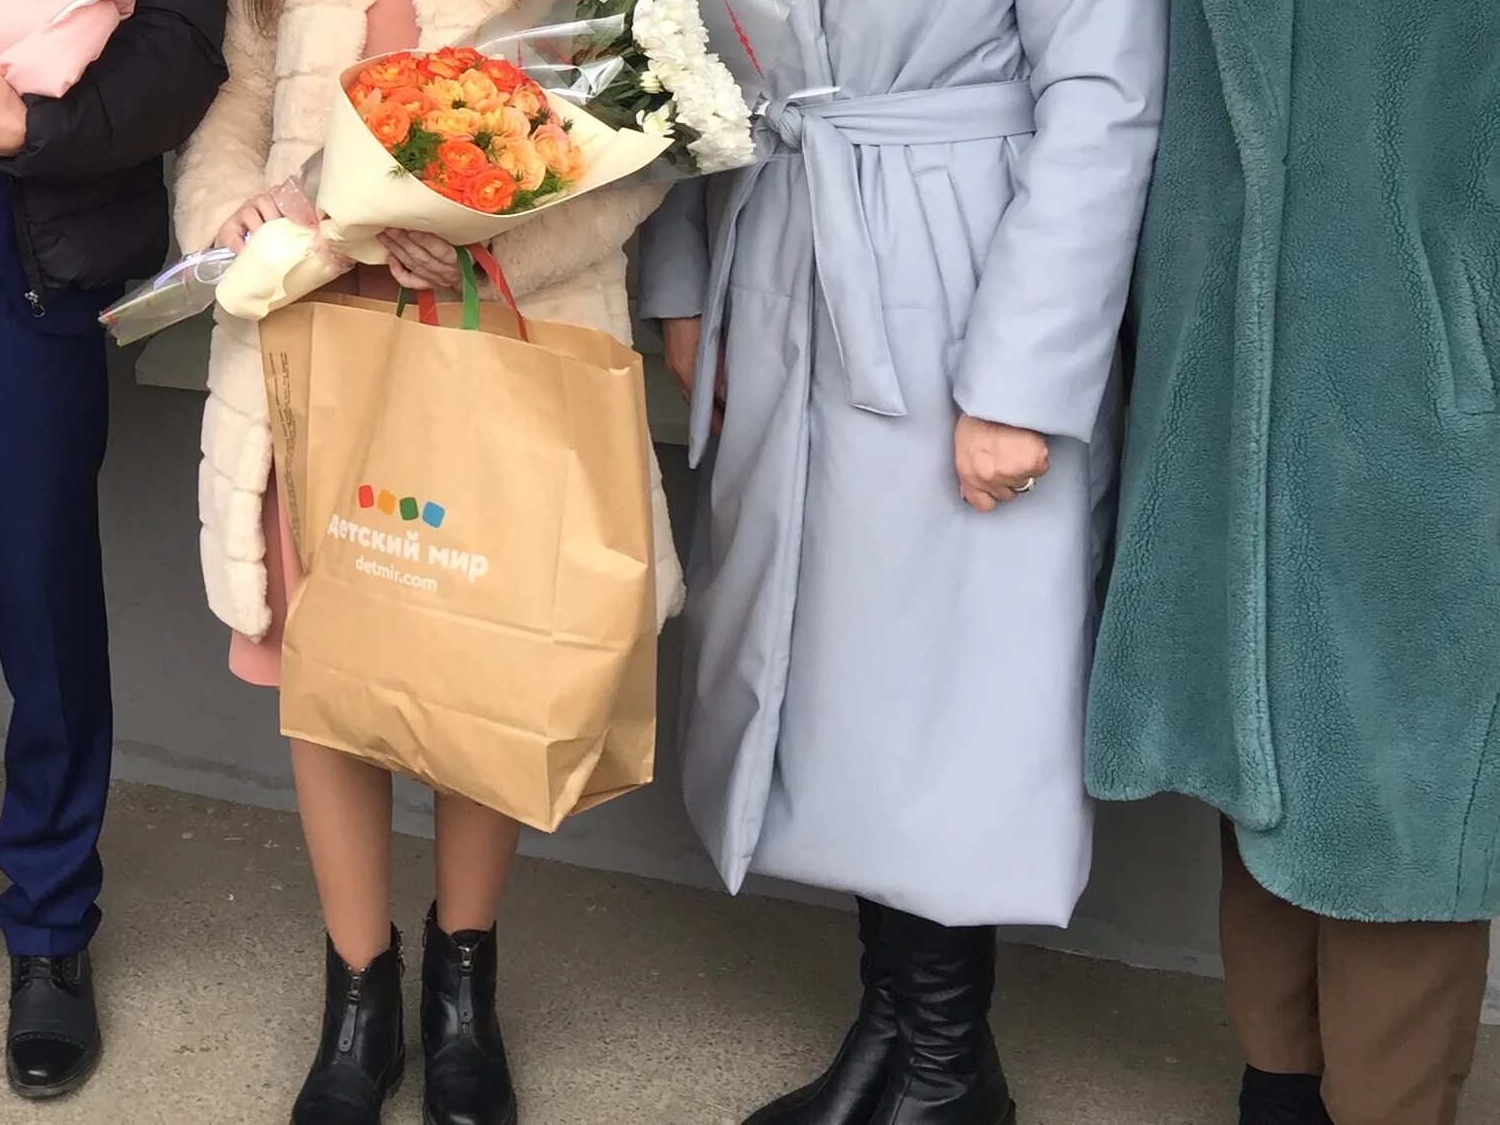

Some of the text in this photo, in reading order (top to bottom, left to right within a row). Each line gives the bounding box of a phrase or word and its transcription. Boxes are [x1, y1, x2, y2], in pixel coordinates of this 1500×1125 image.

[326, 514, 489, 583] детский мир
[355, 555, 438, 592] detmir.com
